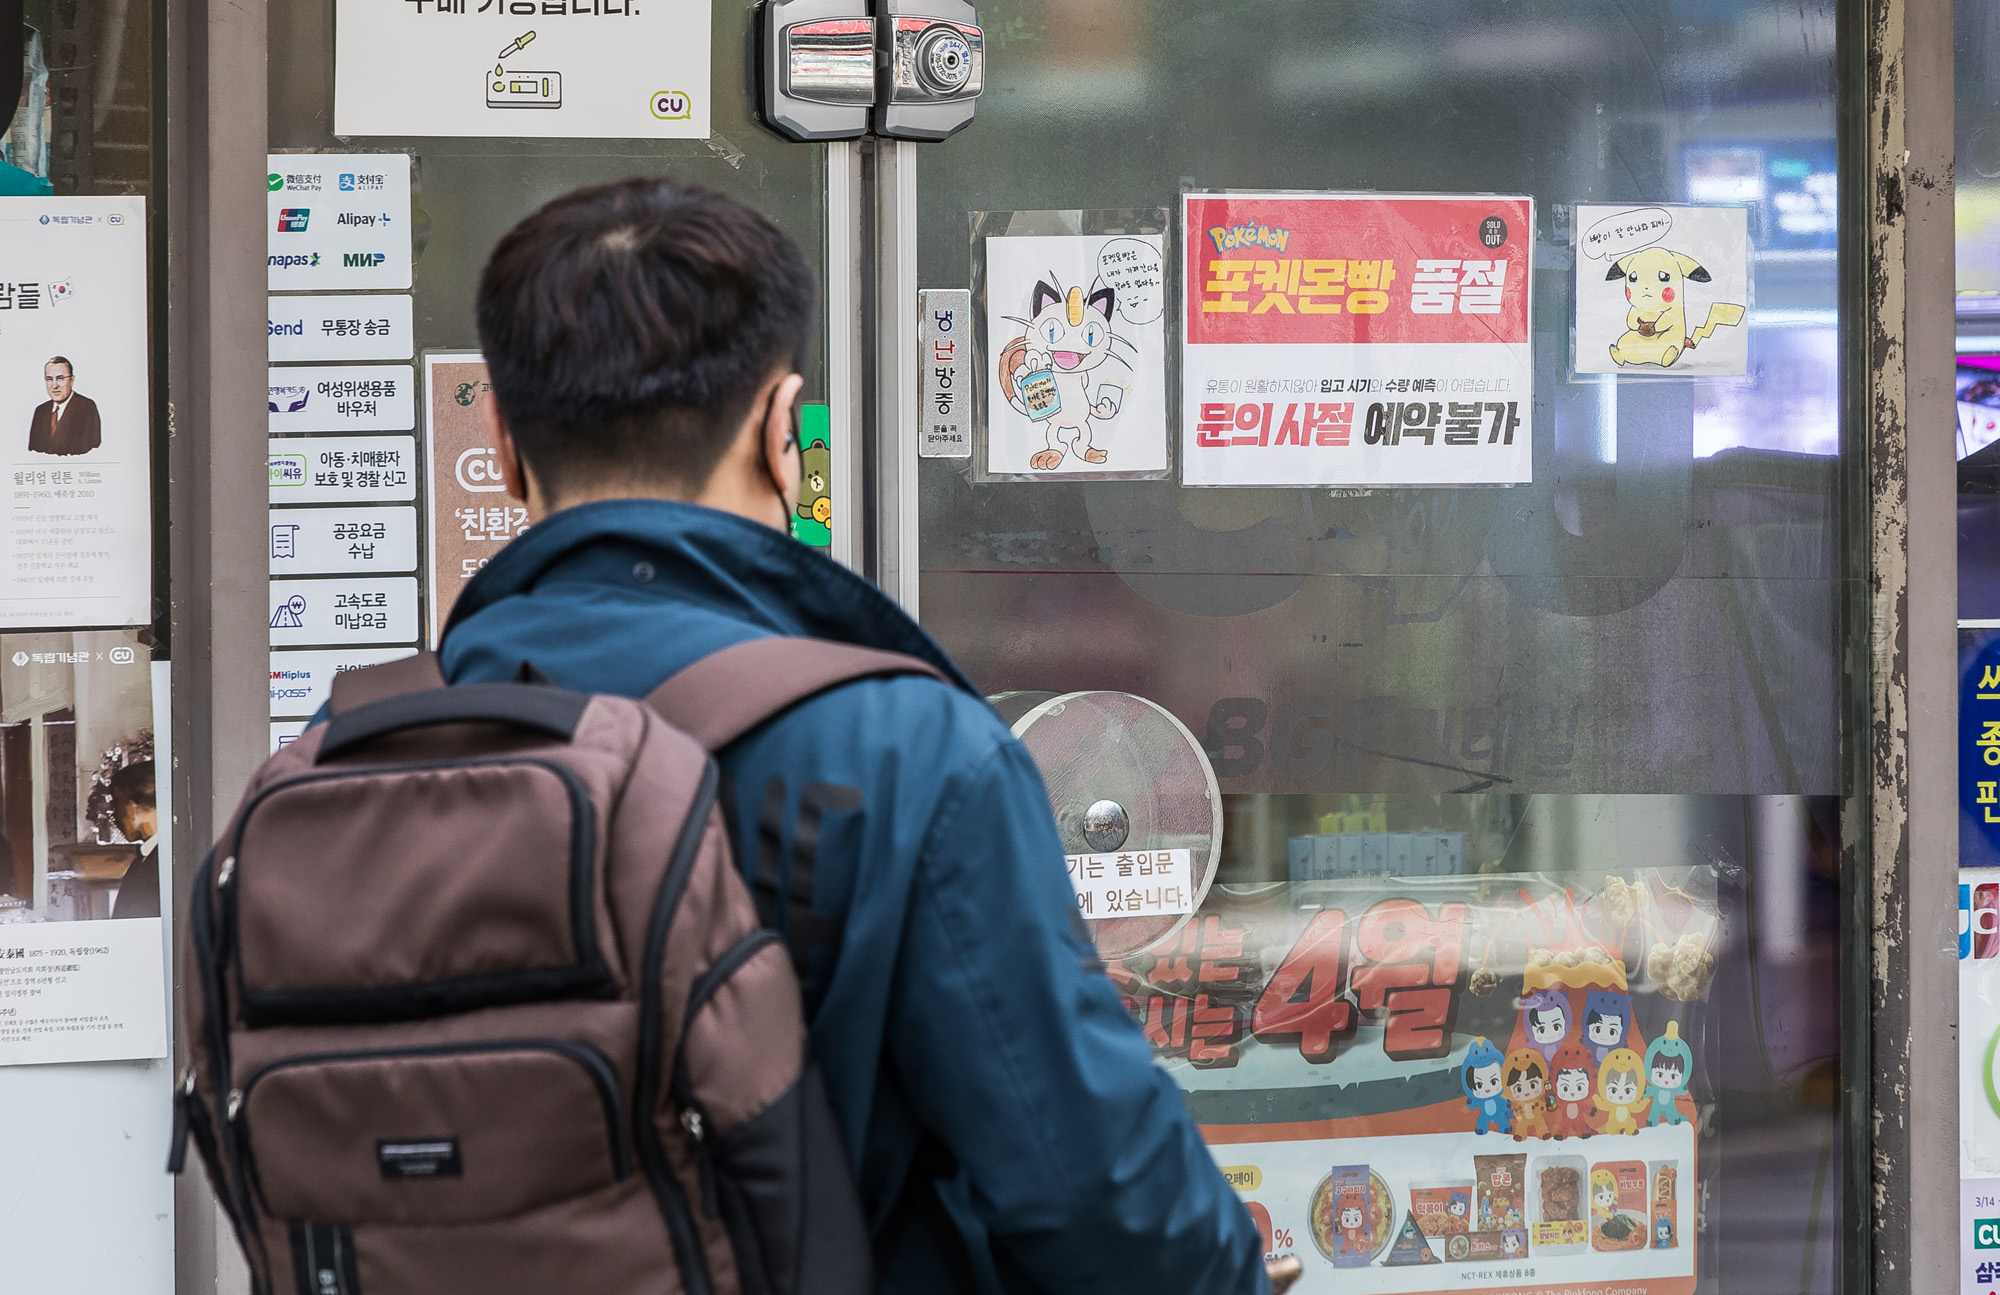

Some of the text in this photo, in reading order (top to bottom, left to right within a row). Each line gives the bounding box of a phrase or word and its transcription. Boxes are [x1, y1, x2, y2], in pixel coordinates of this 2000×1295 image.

[657, 98, 682, 112] CU
[286, 174, 322, 184] 微信支付
[357, 174, 384, 185] 支付宝
[1486, 221, 1501, 229] SOLD
[1485, 234, 1501, 245] OUT
[1589, 230, 1611, 244] 빵이
[1615, 227, 1624, 238] 잘
[267, 255, 309, 269] napas
[1106, 268, 1121, 278] 내가
[1202, 259, 1508, 315] 포켓몬빵 품절
[321, 319, 391, 336] 무통장 송금
[317, 381, 397, 398] 여성위생용품
[1205, 379, 1512, 394] 유통이 원활하지않아 입고 시기와 수량 예측이 어렵습니다.
[337, 400, 377, 417] 바우처
[933, 424, 958, 433] 문을 꼭
[927, 434, 963, 443] 닫아주세요
[314, 470, 407, 488] 보호 및 경찰 신고
[333, 523, 386, 540] 공공요금
[348, 542, 375, 559] 수납
[334, 593, 388, 610] 고속도로
[335, 612, 388, 630] 미납요금
[31, 651, 90, 665] 독립기념관
[113, 650, 129, 660] CU
[1115, 852, 1174, 877] 출입문
[1106, 885, 1188, 913] 있습니다.
[1254, 898, 1467, 1056] 4월
[1461, 1267, 1536, 1281] NCT-REX 제휴상품 8종
